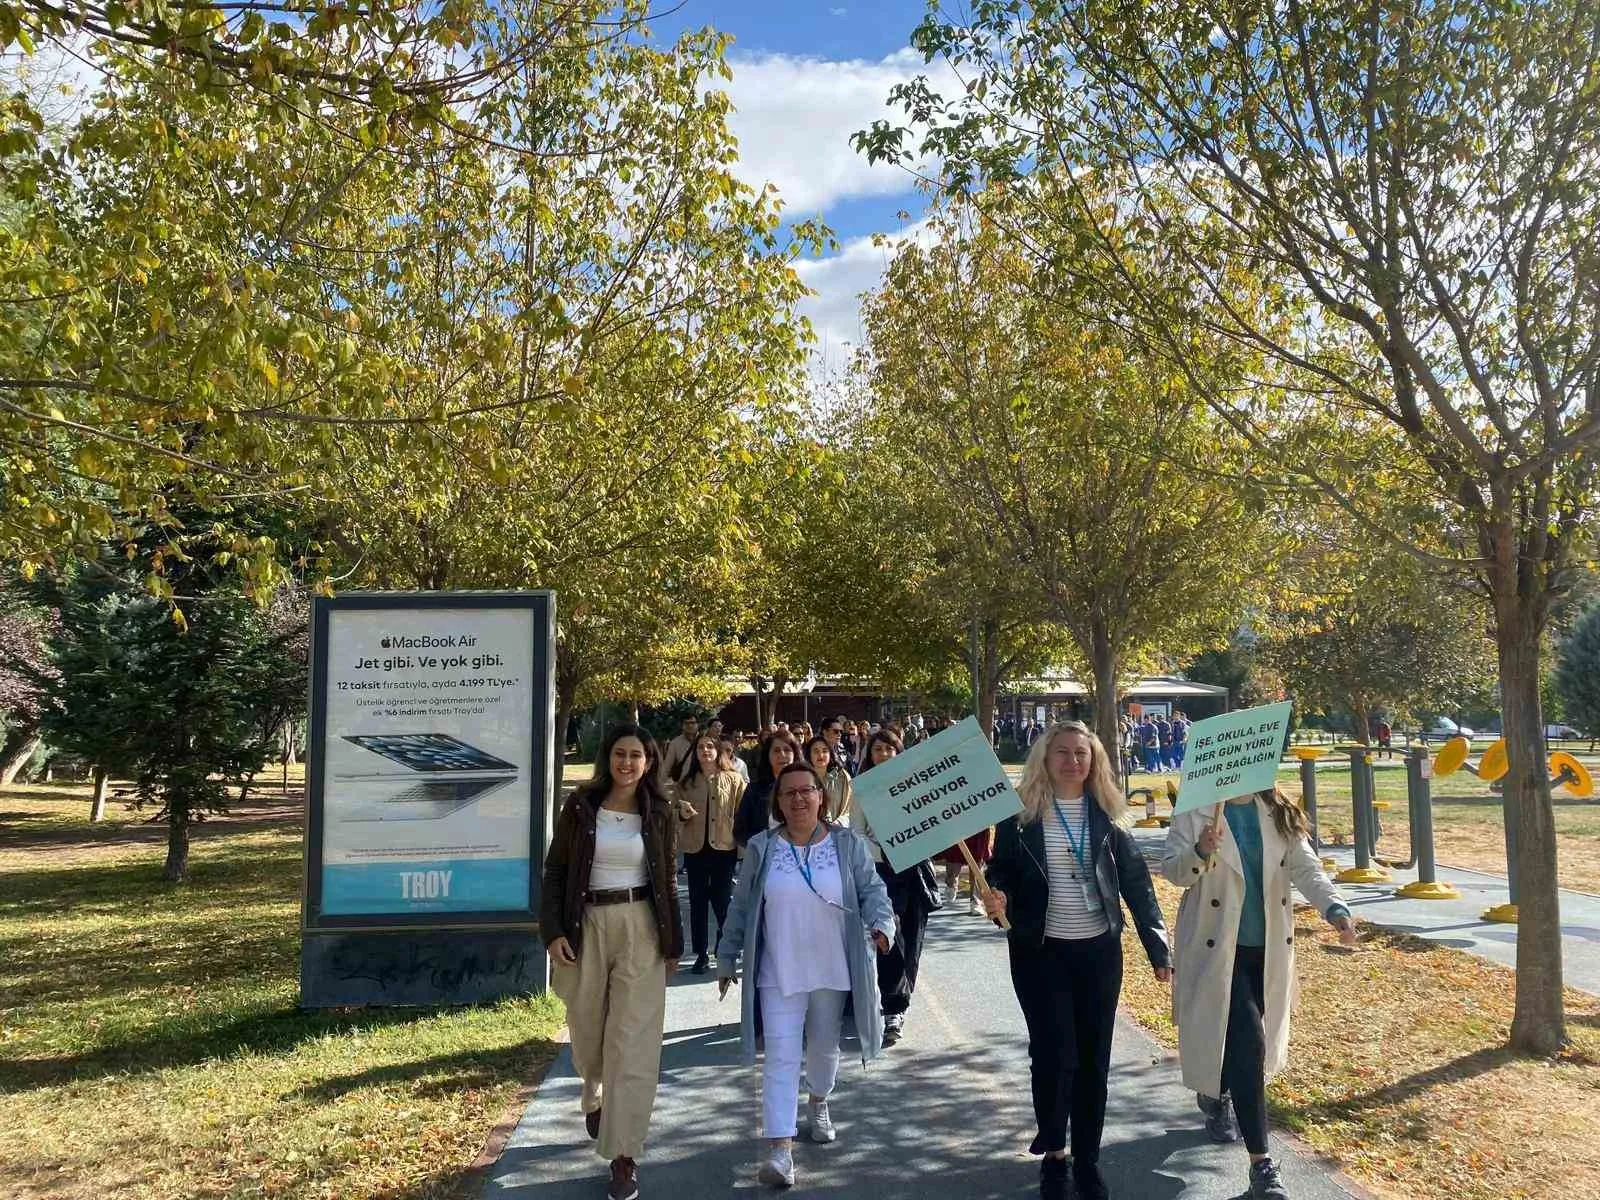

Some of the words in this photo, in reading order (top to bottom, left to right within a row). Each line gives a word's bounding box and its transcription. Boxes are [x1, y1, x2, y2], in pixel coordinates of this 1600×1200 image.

[393, 636, 456, 648] MacBook
[459, 635, 477, 647] Air
[355, 657, 379, 669] Jet
[384, 656, 414, 671] gibi.
[418, 656, 437, 667] Ve
[441, 654, 467, 670] yok
[472, 653, 503, 669] gibi.
[337, 681, 348, 690] 12
[351, 681, 380, 690] taksit
[432, 679, 457, 690] ayda
[459, 679, 485, 688] 4.199
[399, 708, 427, 716] indirim
[1217, 727, 1256, 743] OKULA,
[1259, 721, 1280, 733] EVE
[1195, 751, 1216, 764] HER
[1218, 744, 1242, 757] GÜN
[1245, 737, 1274, 750] YÜRÜ
[889, 754, 961, 797] ESKİŞEHİR
[1187, 763, 1223, 780] BUDUR
[1225, 751, 1275, 770] SAĞLIĞIN
[901, 776, 968, 814] YÜRÜYOR
[885, 816, 940, 849] YÜZLER
[941, 782, 1007, 821] GÜLÜYOR
[399, 870, 453, 899] TROY
